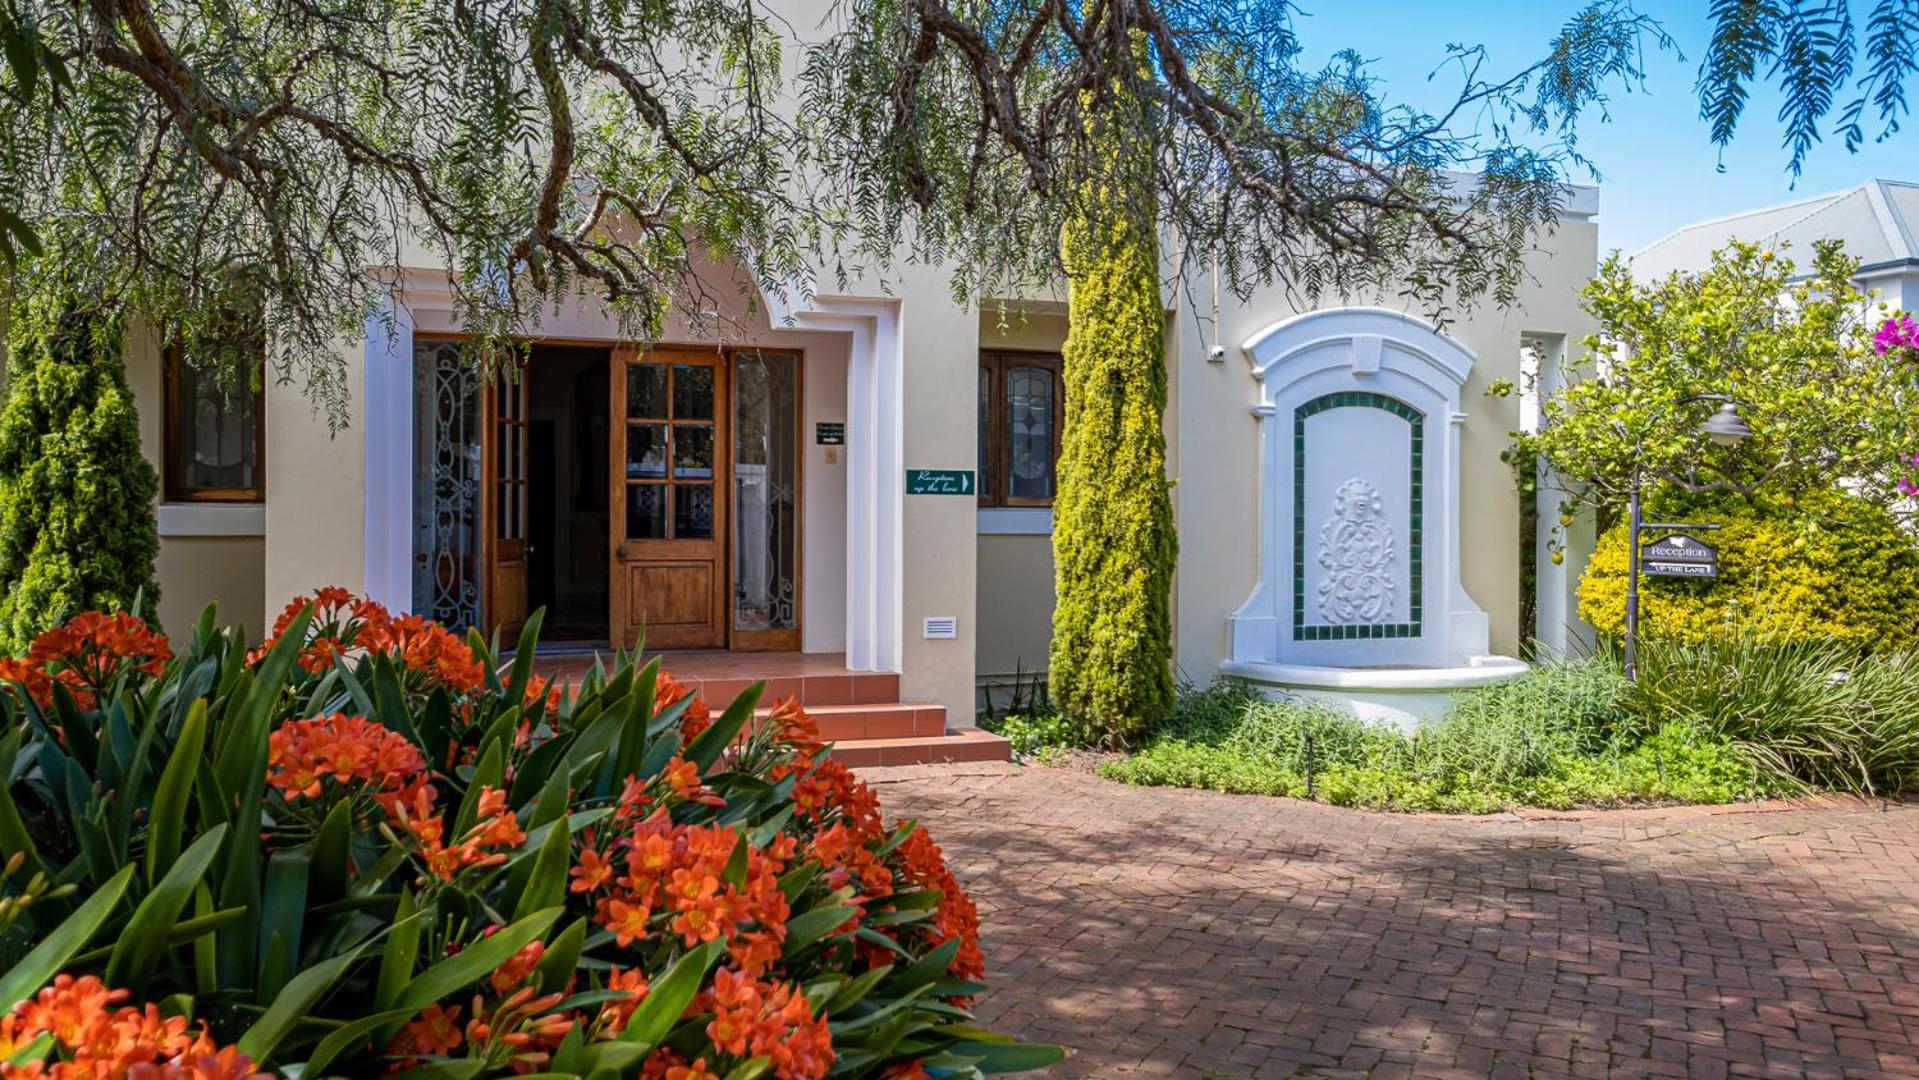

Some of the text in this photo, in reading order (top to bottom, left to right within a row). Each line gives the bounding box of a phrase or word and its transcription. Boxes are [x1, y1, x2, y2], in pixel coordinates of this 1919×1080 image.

[917, 470, 955, 483] Reception
[927, 481, 939, 491] the
[1651, 546, 1706, 557] Reception
